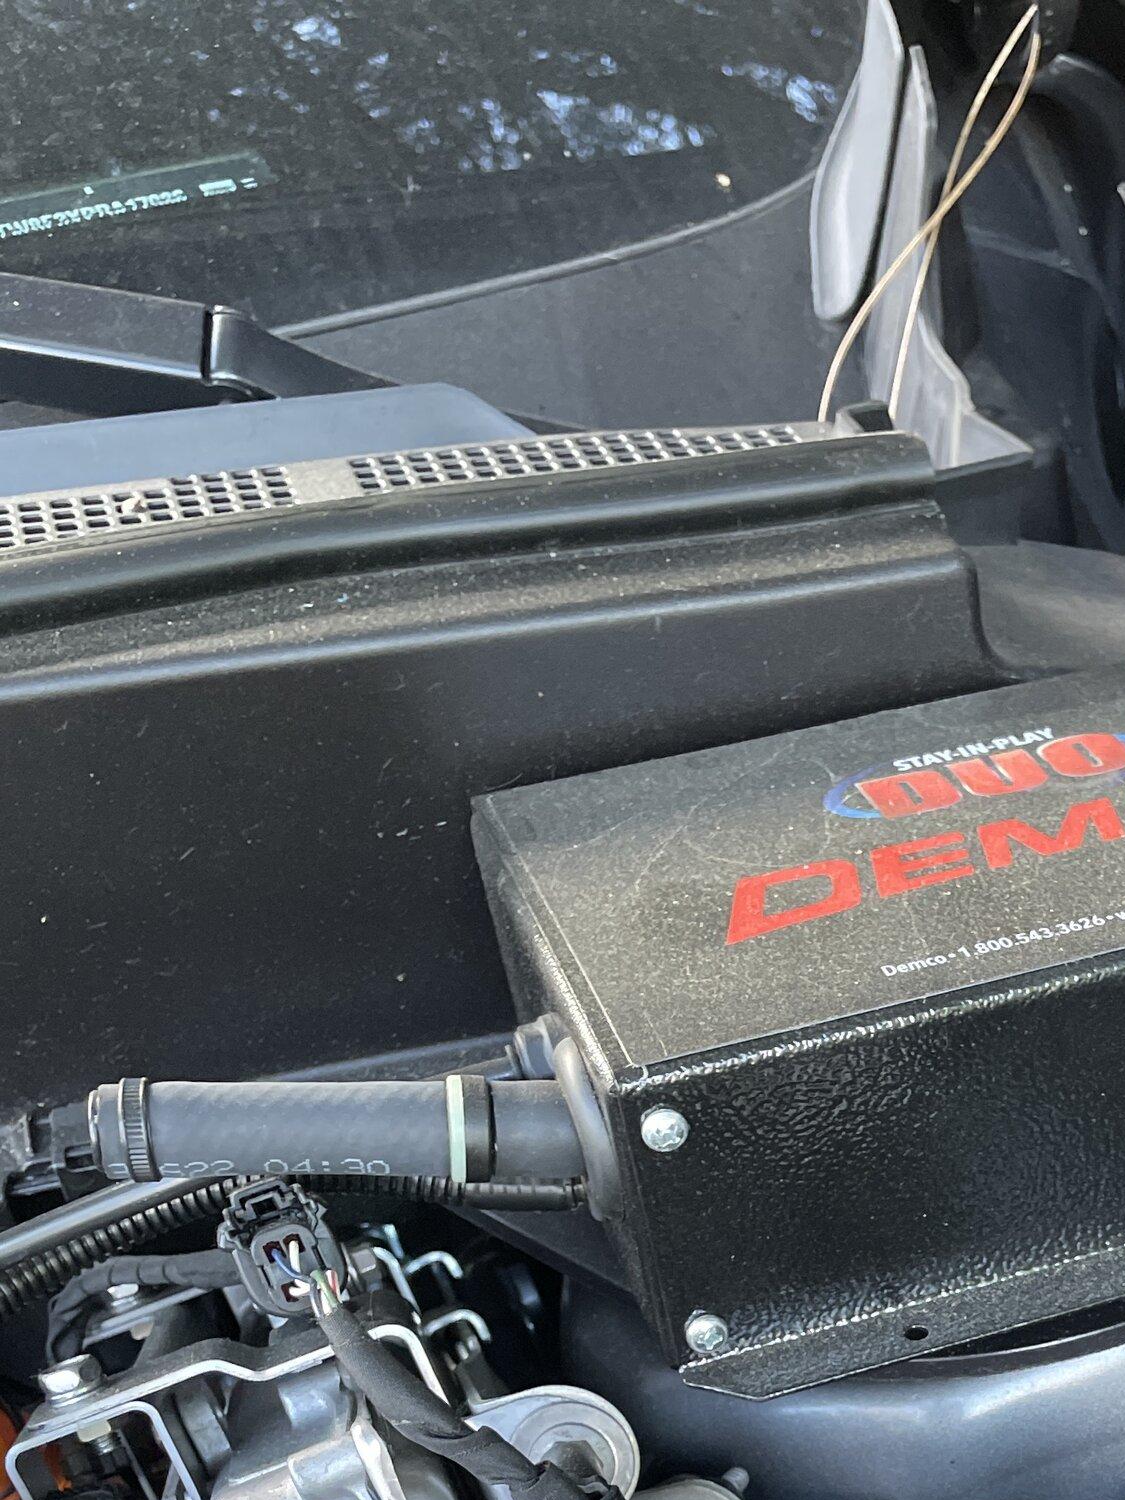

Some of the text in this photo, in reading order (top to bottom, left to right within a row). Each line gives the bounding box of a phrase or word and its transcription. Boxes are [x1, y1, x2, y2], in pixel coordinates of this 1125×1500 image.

[892, 727, 1057, 772] STAY-IN-PLAY
[880, 952, 948, 978] Demco
[956, 914, 1107, 961] 1.800.543.3626
